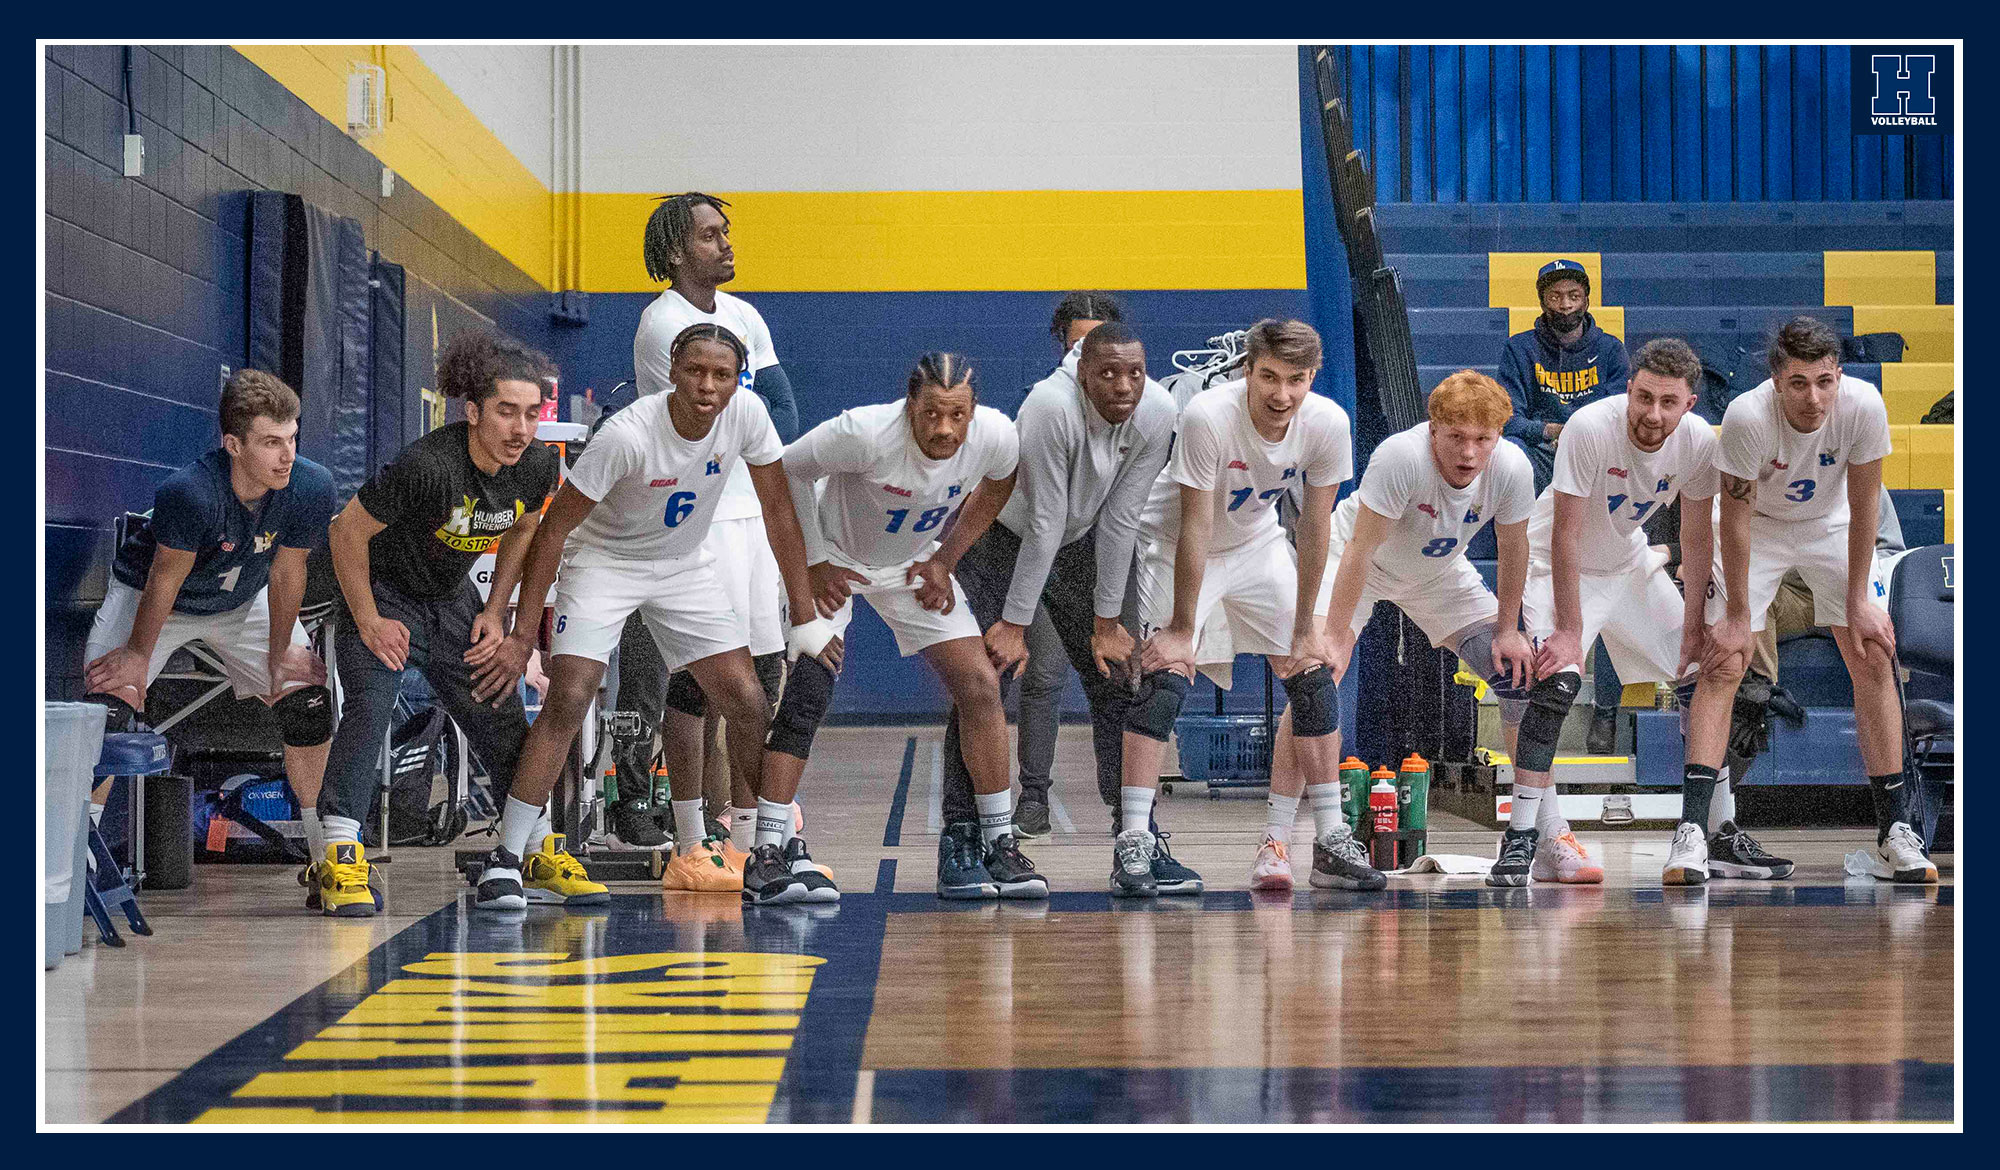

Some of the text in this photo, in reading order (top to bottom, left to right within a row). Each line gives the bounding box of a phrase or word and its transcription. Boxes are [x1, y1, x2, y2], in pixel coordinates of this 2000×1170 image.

[1783, 478, 1817, 503] 3
[473, 508, 515, 523] HUMBER
[663, 490, 698, 528] 6
[472, 518, 514, 531] STRENGTH
[884, 506, 950, 534] 18
[1421, 537, 1459, 558] 8
[217, 565, 243, 592] 1
[556, 615, 568, 634] 6
[247, 791, 285, 800] OXYGEN
